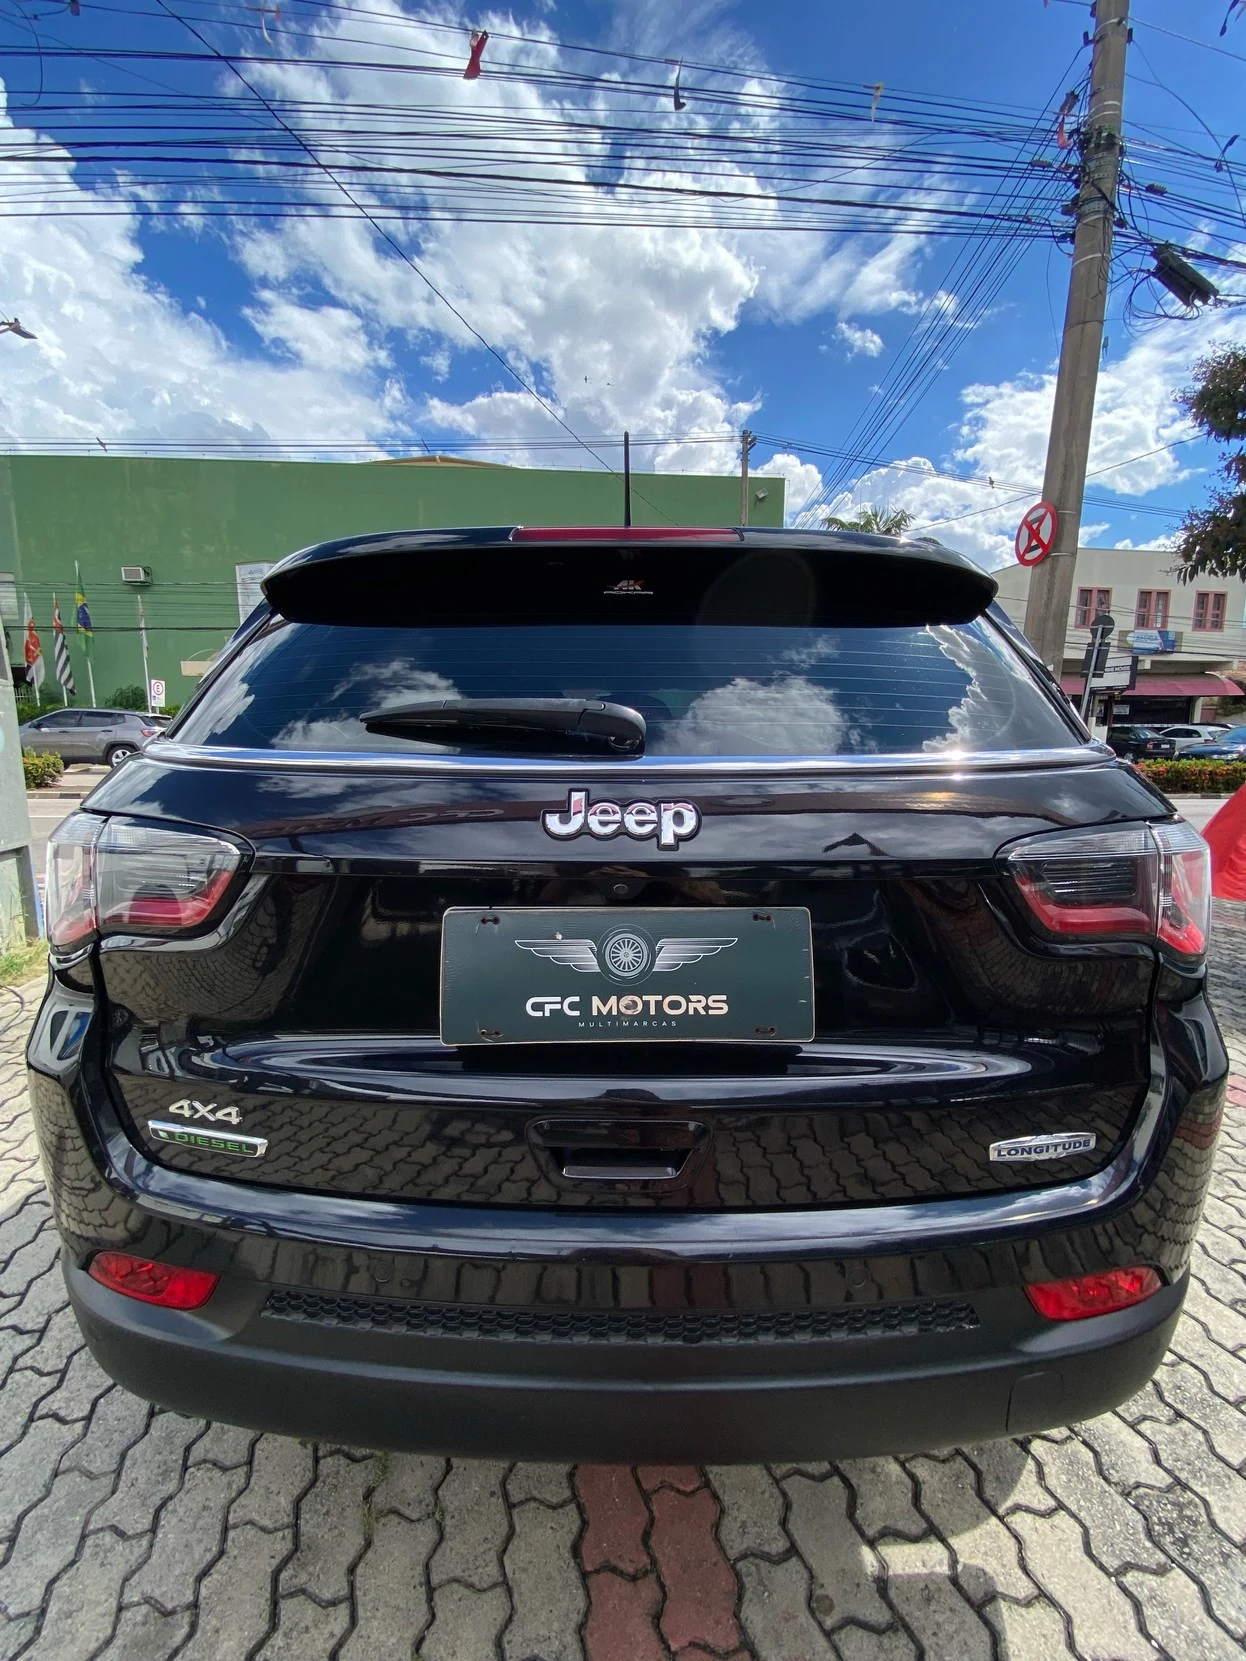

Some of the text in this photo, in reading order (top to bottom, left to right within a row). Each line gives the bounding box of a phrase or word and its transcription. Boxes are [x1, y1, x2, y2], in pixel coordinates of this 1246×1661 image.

[543, 788, 701, 850] Jeep
[525, 994, 729, 1017] CFC MOTORS
[578, 1020, 677, 1028] MULTIMARCAS
[174, 1131, 255, 1154] DIESEL
[996, 1138, 1092, 1158] LONGITUDE
